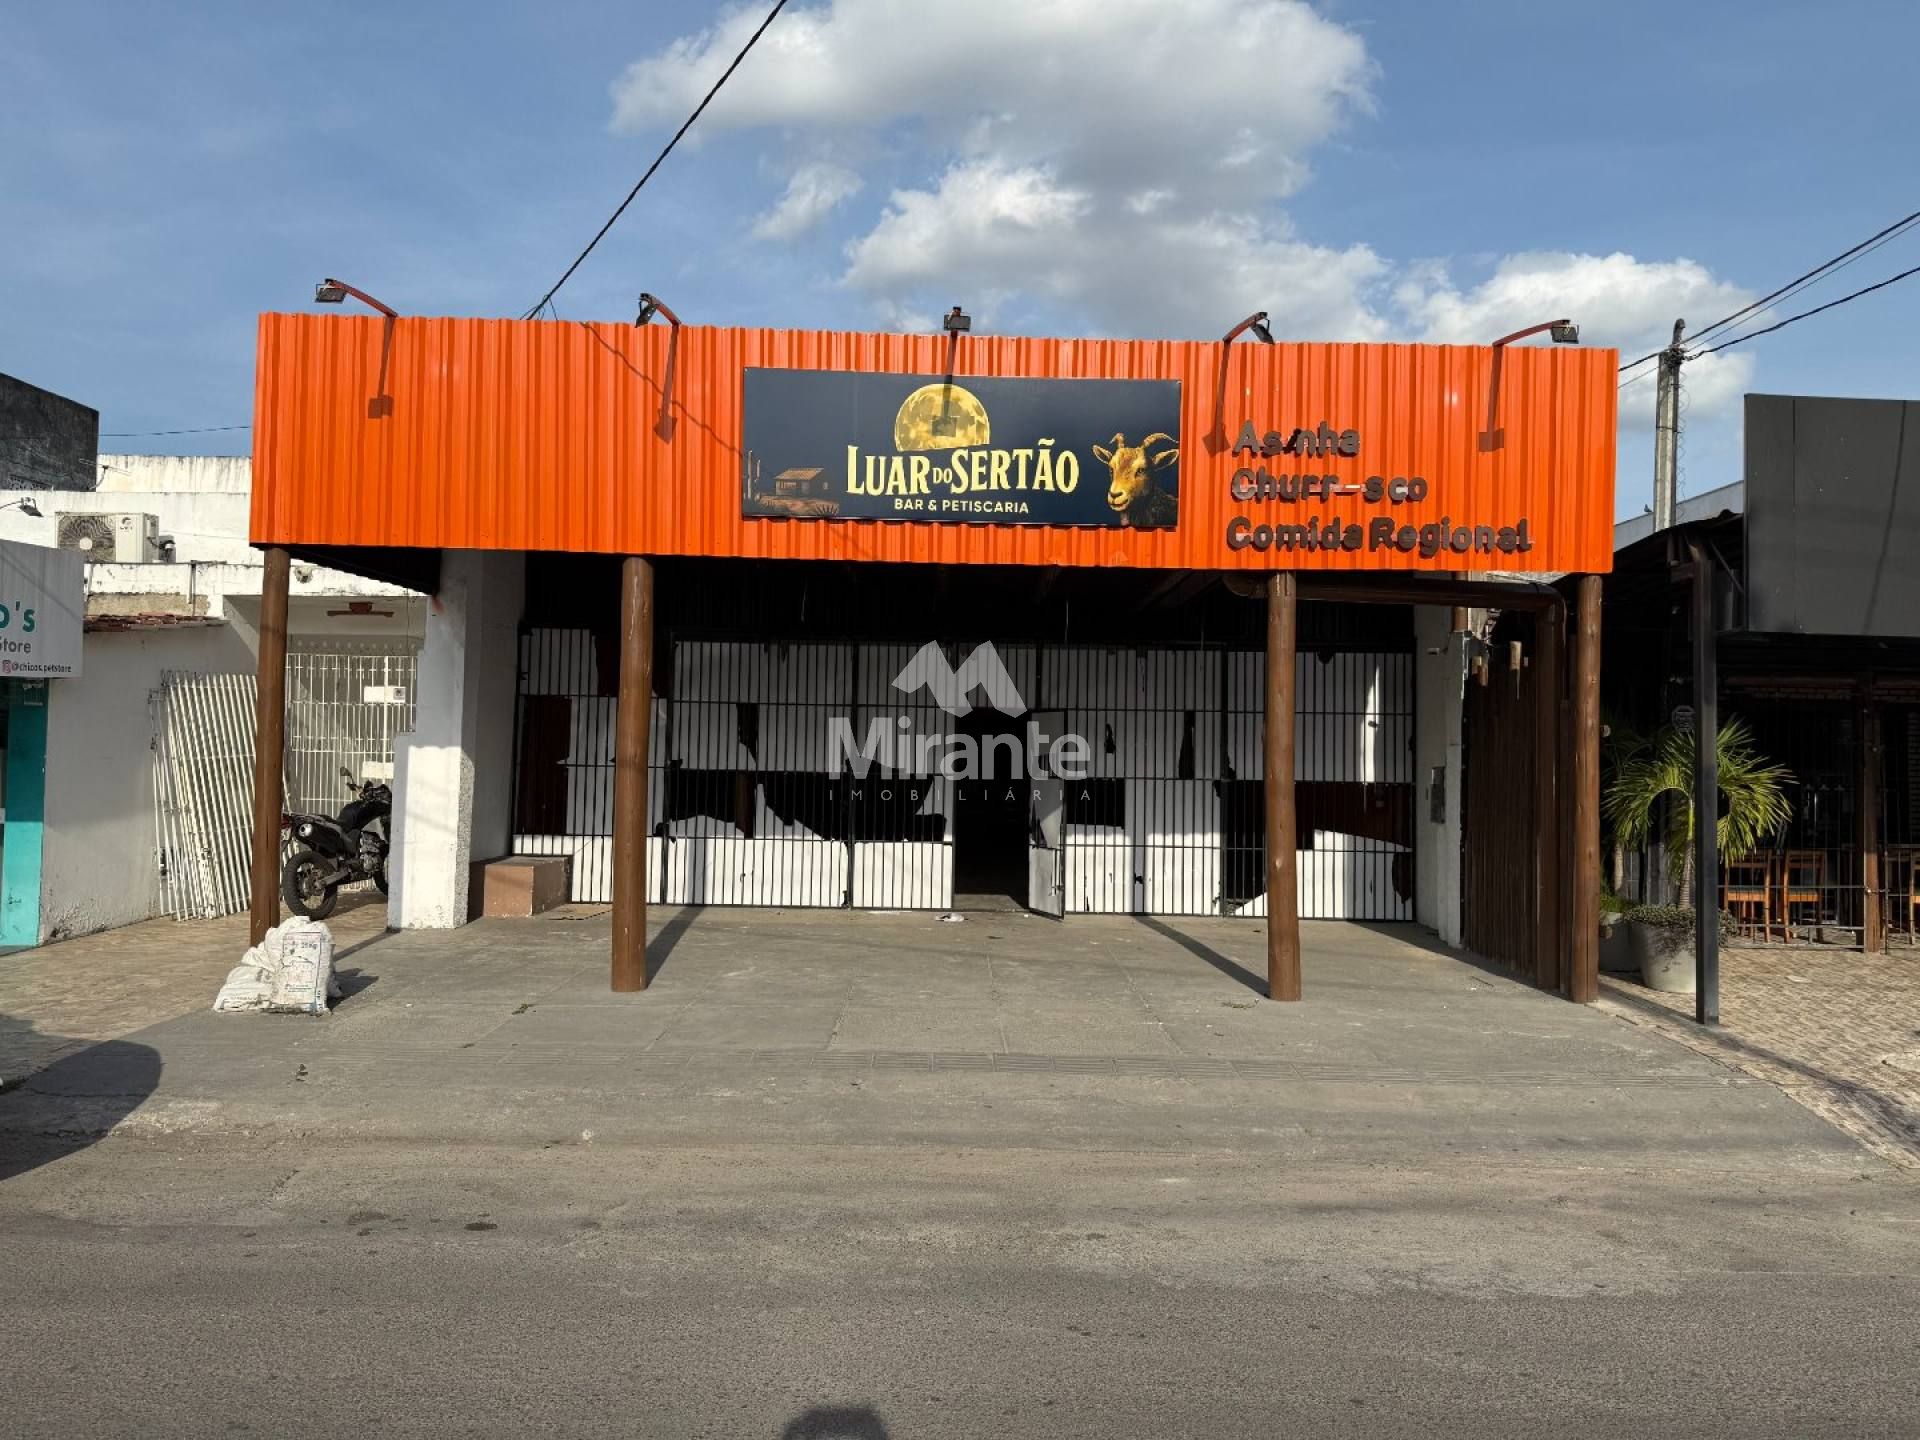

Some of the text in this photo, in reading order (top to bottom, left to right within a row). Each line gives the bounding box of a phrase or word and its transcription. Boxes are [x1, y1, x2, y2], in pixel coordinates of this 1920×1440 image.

[846, 438, 1080, 496] LUAR DO SERTÃO
[894, 498, 1029, 514] BAR & PETISCARIA
[1226, 515, 1533, 559] Comida Regional
[0, 636, 32, 654] tore
